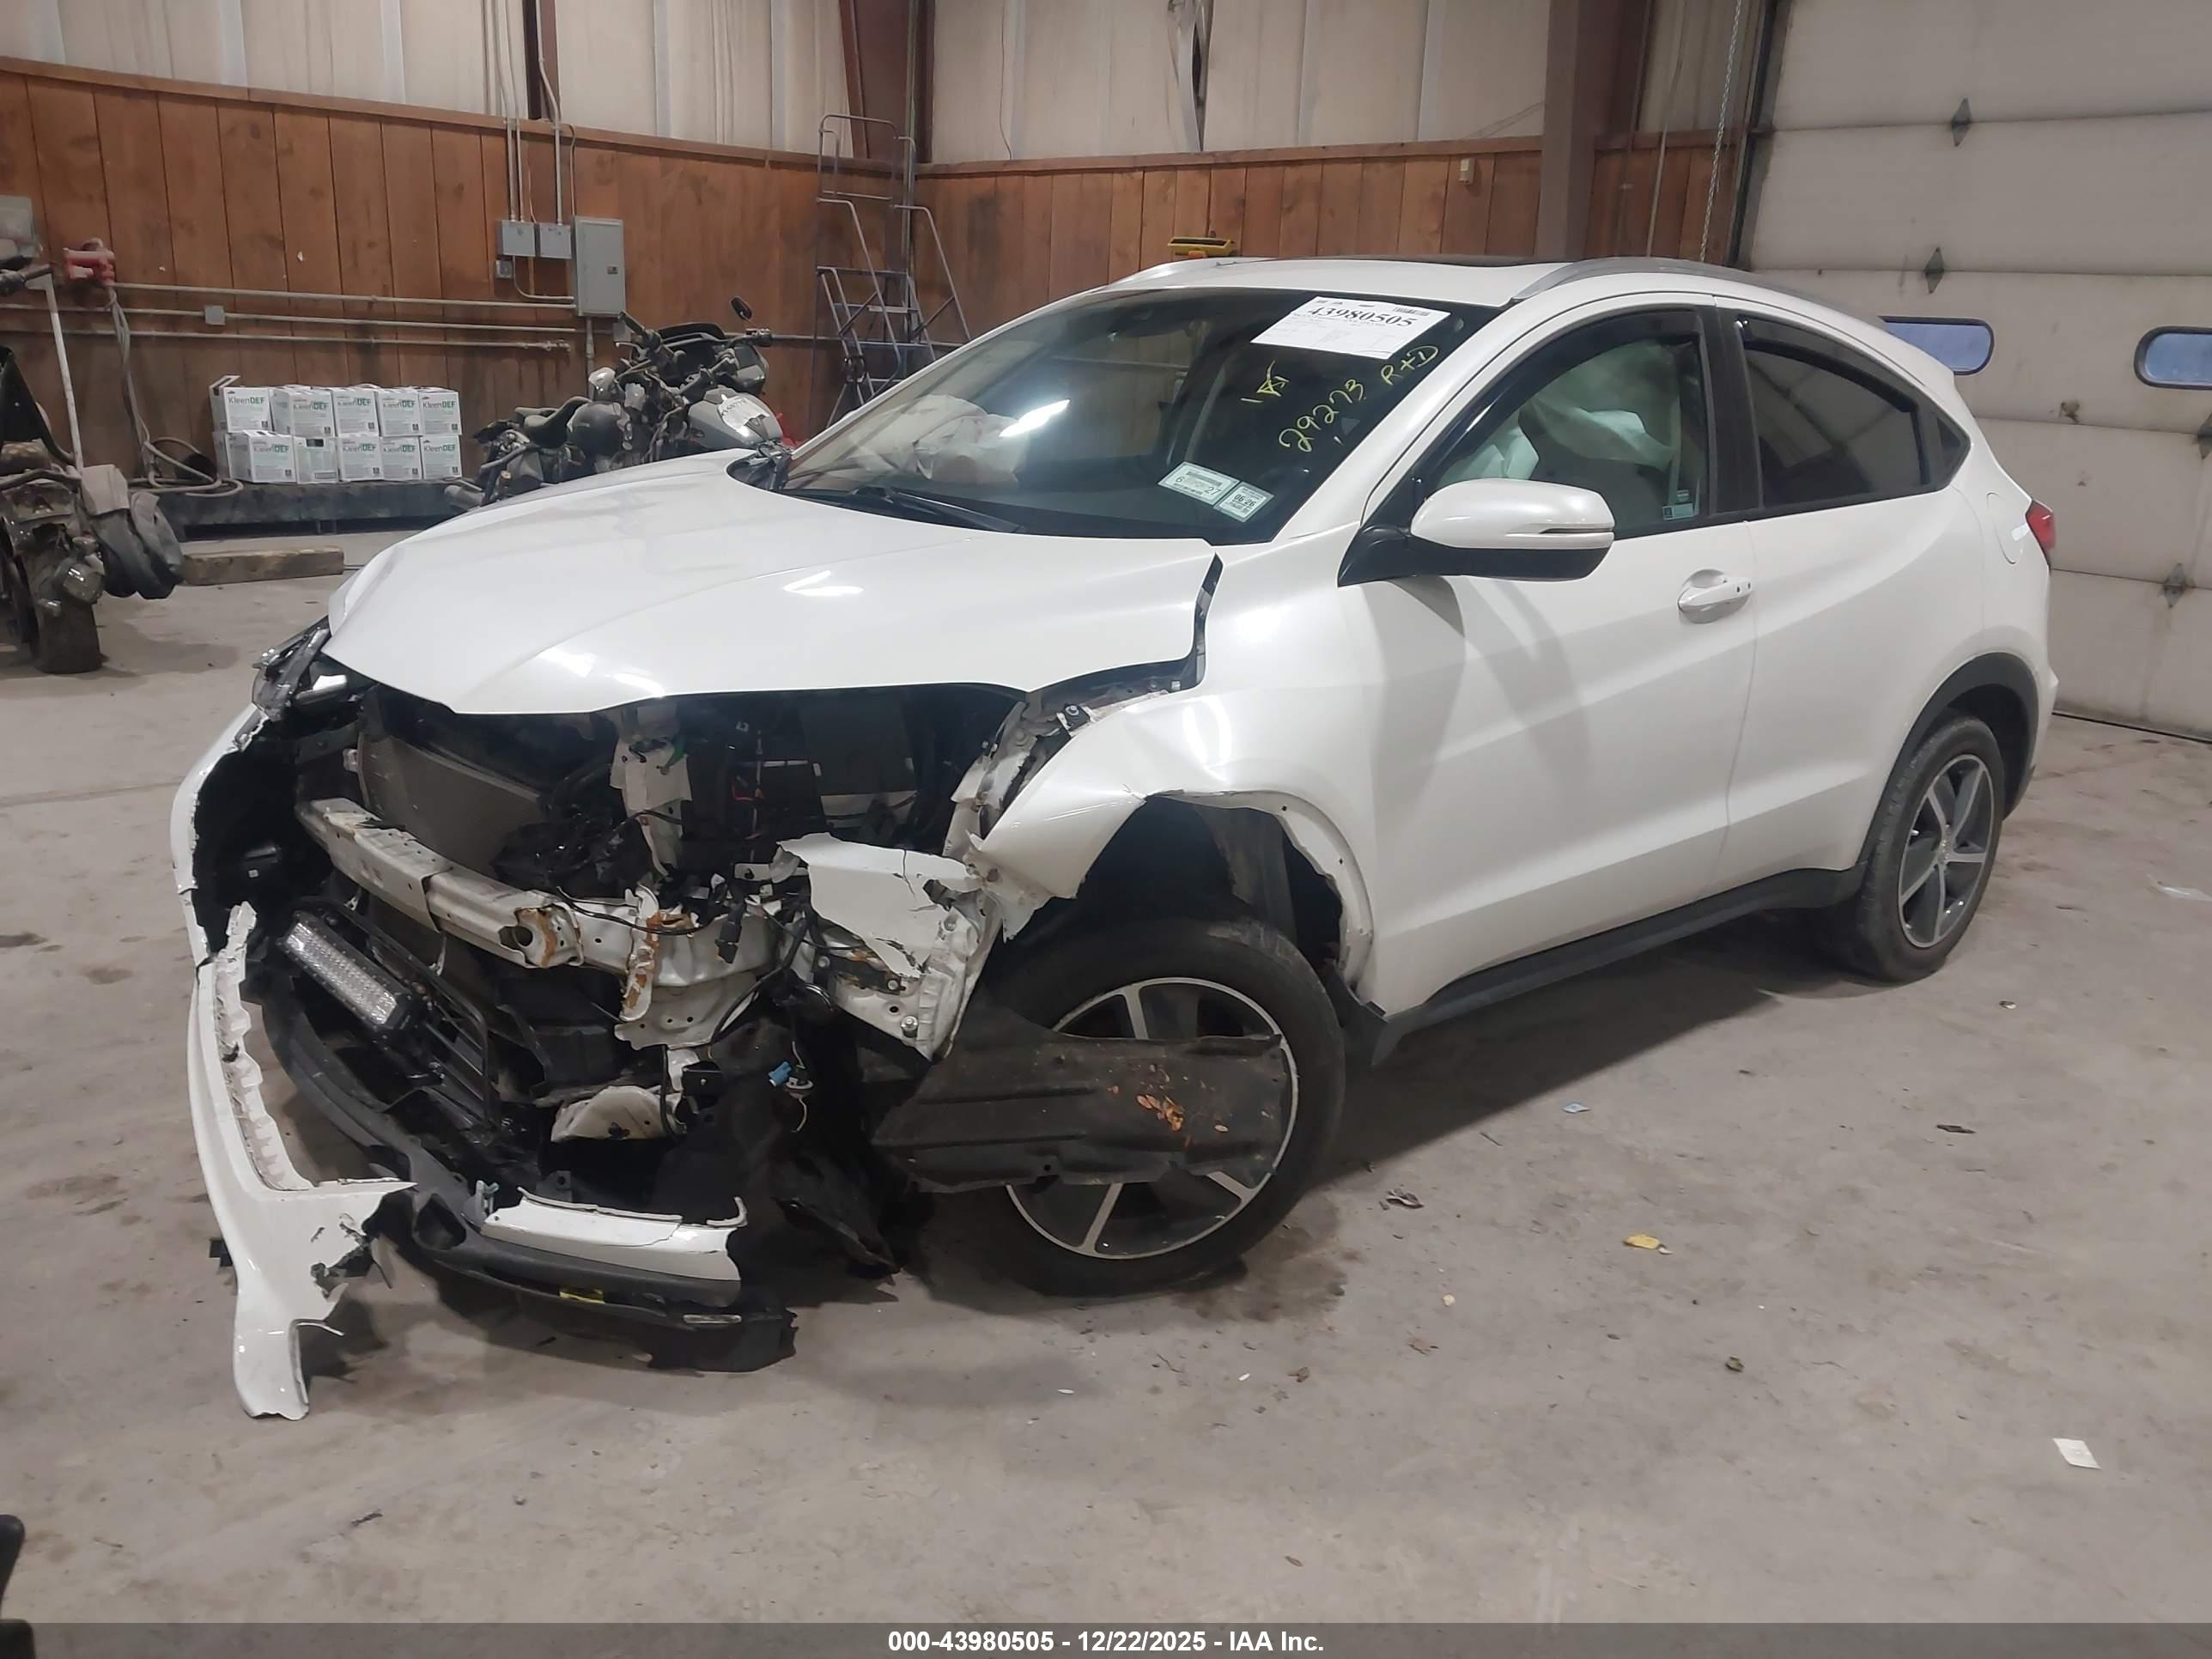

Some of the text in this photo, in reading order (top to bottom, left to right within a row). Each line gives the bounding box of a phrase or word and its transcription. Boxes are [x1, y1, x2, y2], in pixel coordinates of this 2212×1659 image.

[1308, 307, 1418, 327] 43980505
[422, 400, 456, 409] KleenDEF
[1204, 486, 1223, 495] 27
